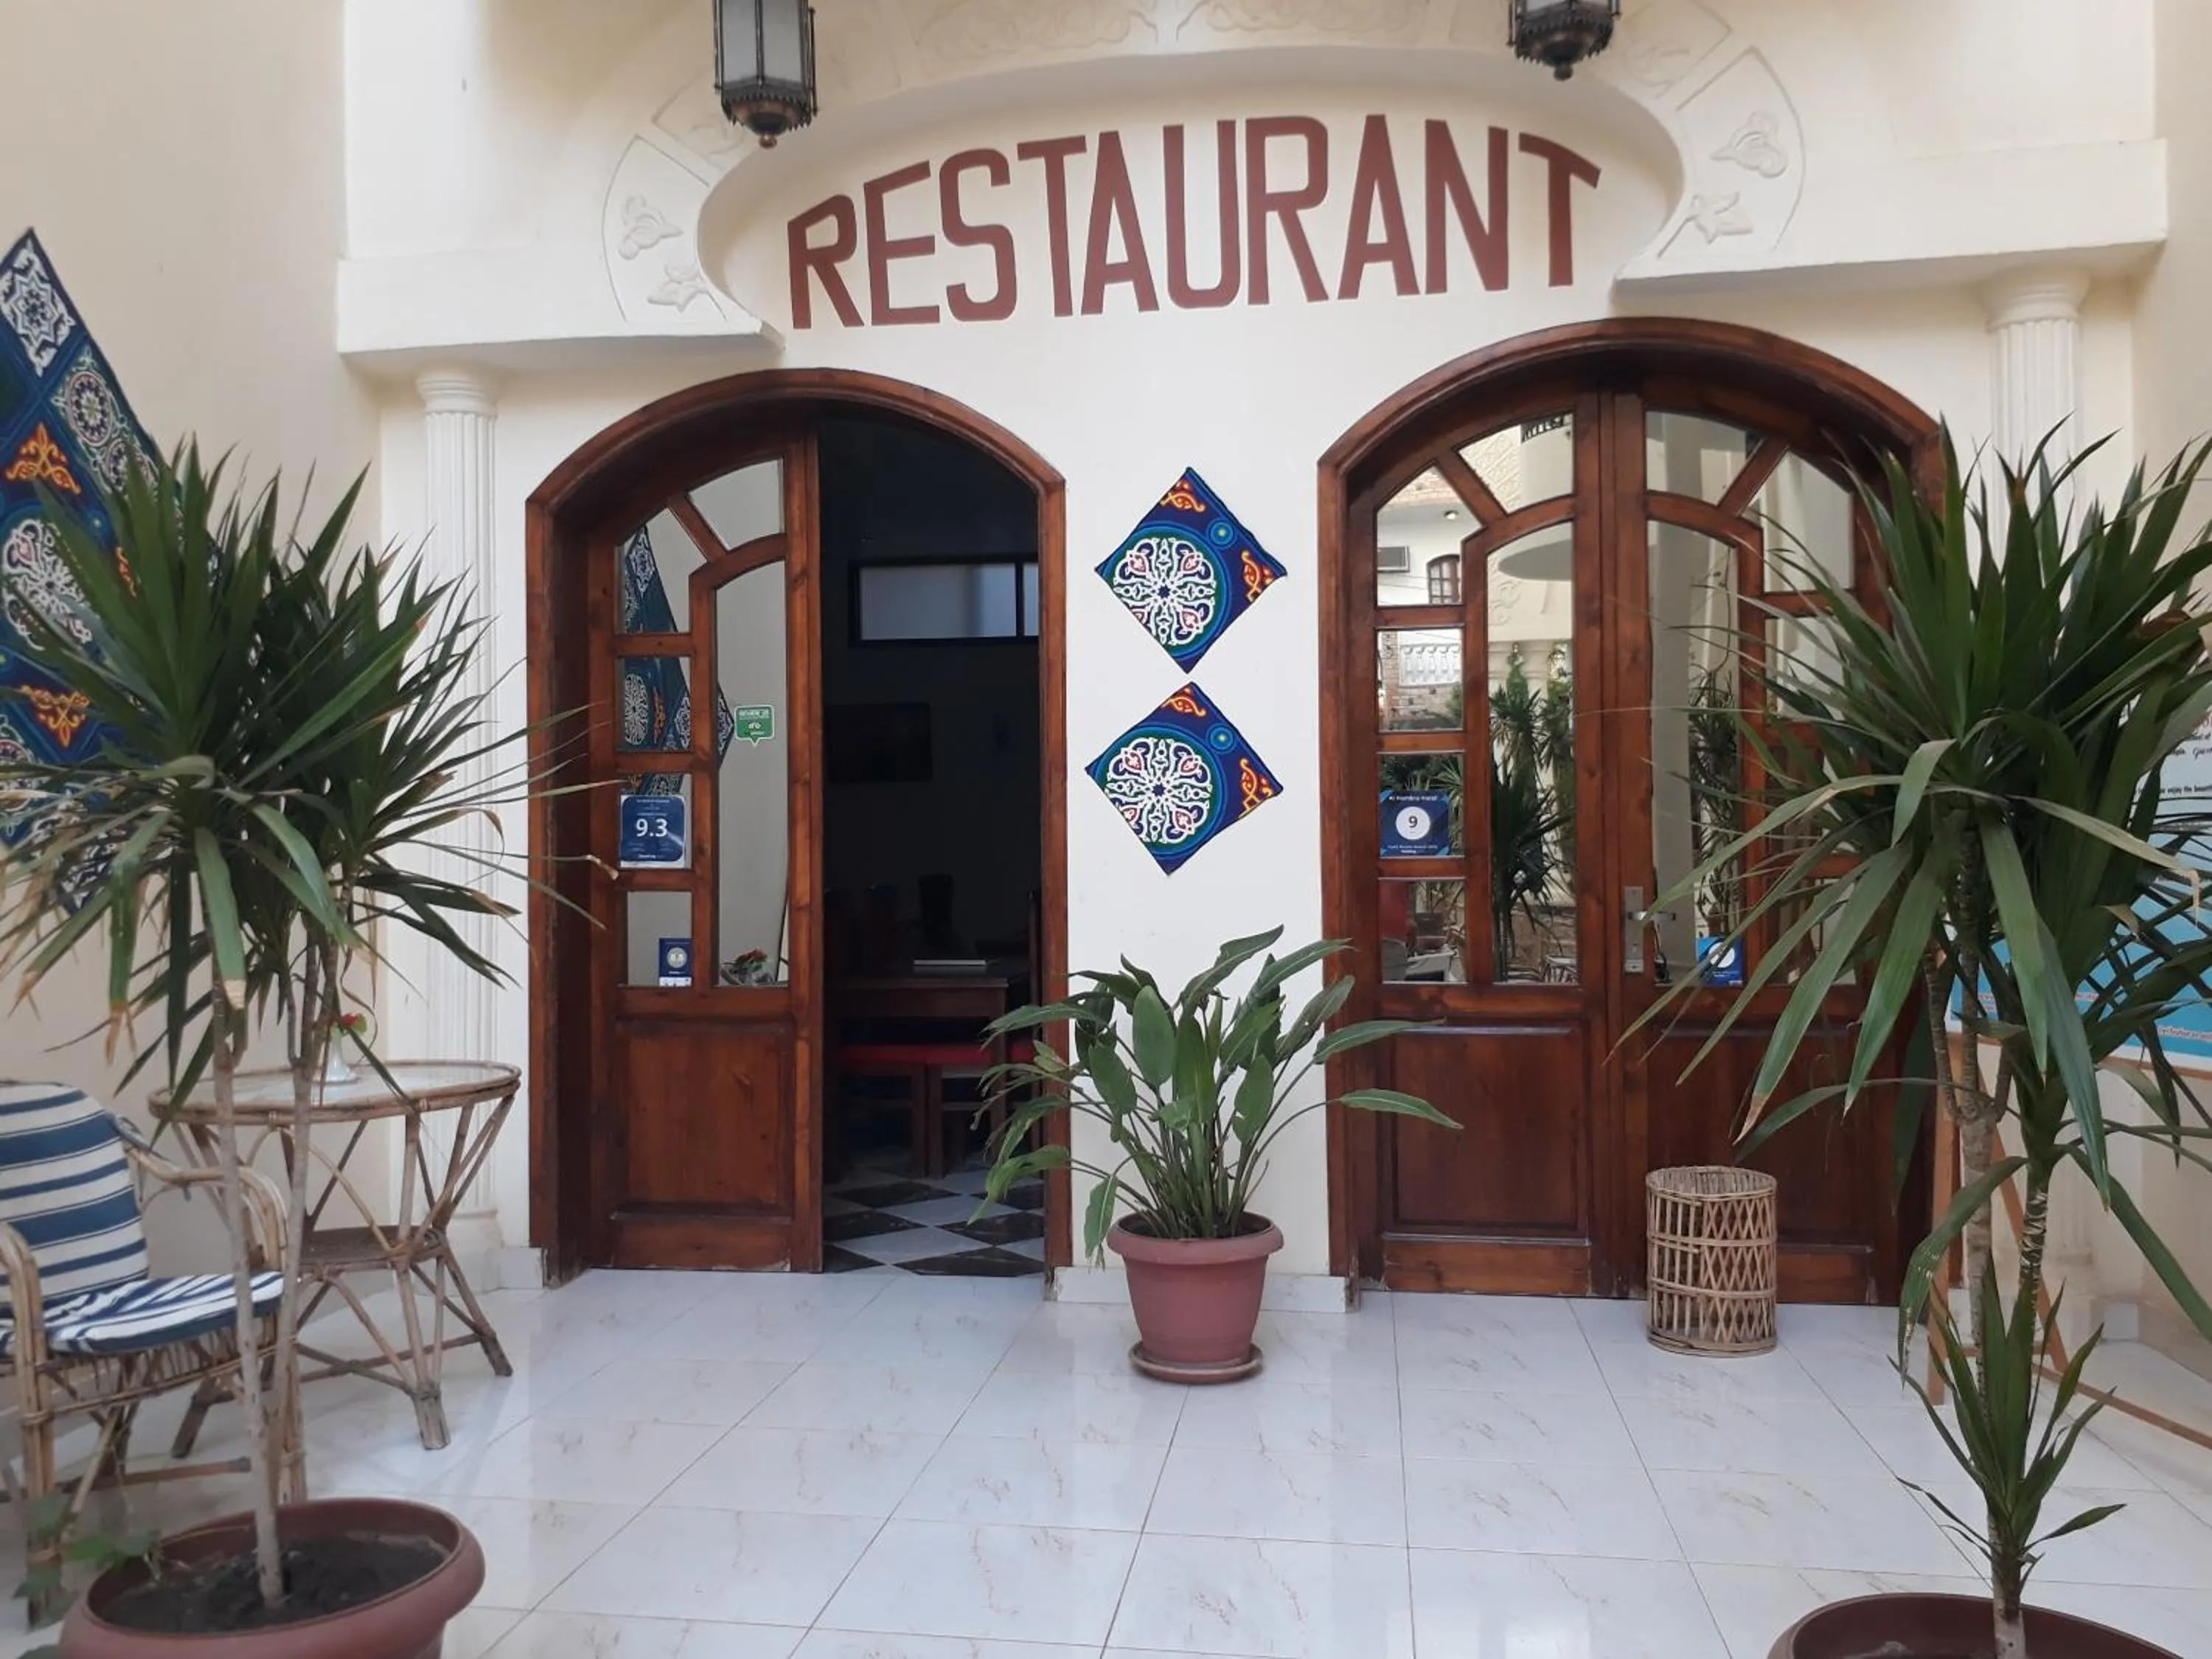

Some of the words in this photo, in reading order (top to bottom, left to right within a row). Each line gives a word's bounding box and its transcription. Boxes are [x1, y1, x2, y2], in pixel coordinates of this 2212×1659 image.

[787, 114, 1601, 330] RESTAURANT
[636, 818, 668, 838] 9.3
[1408, 815, 1418, 828] 9
